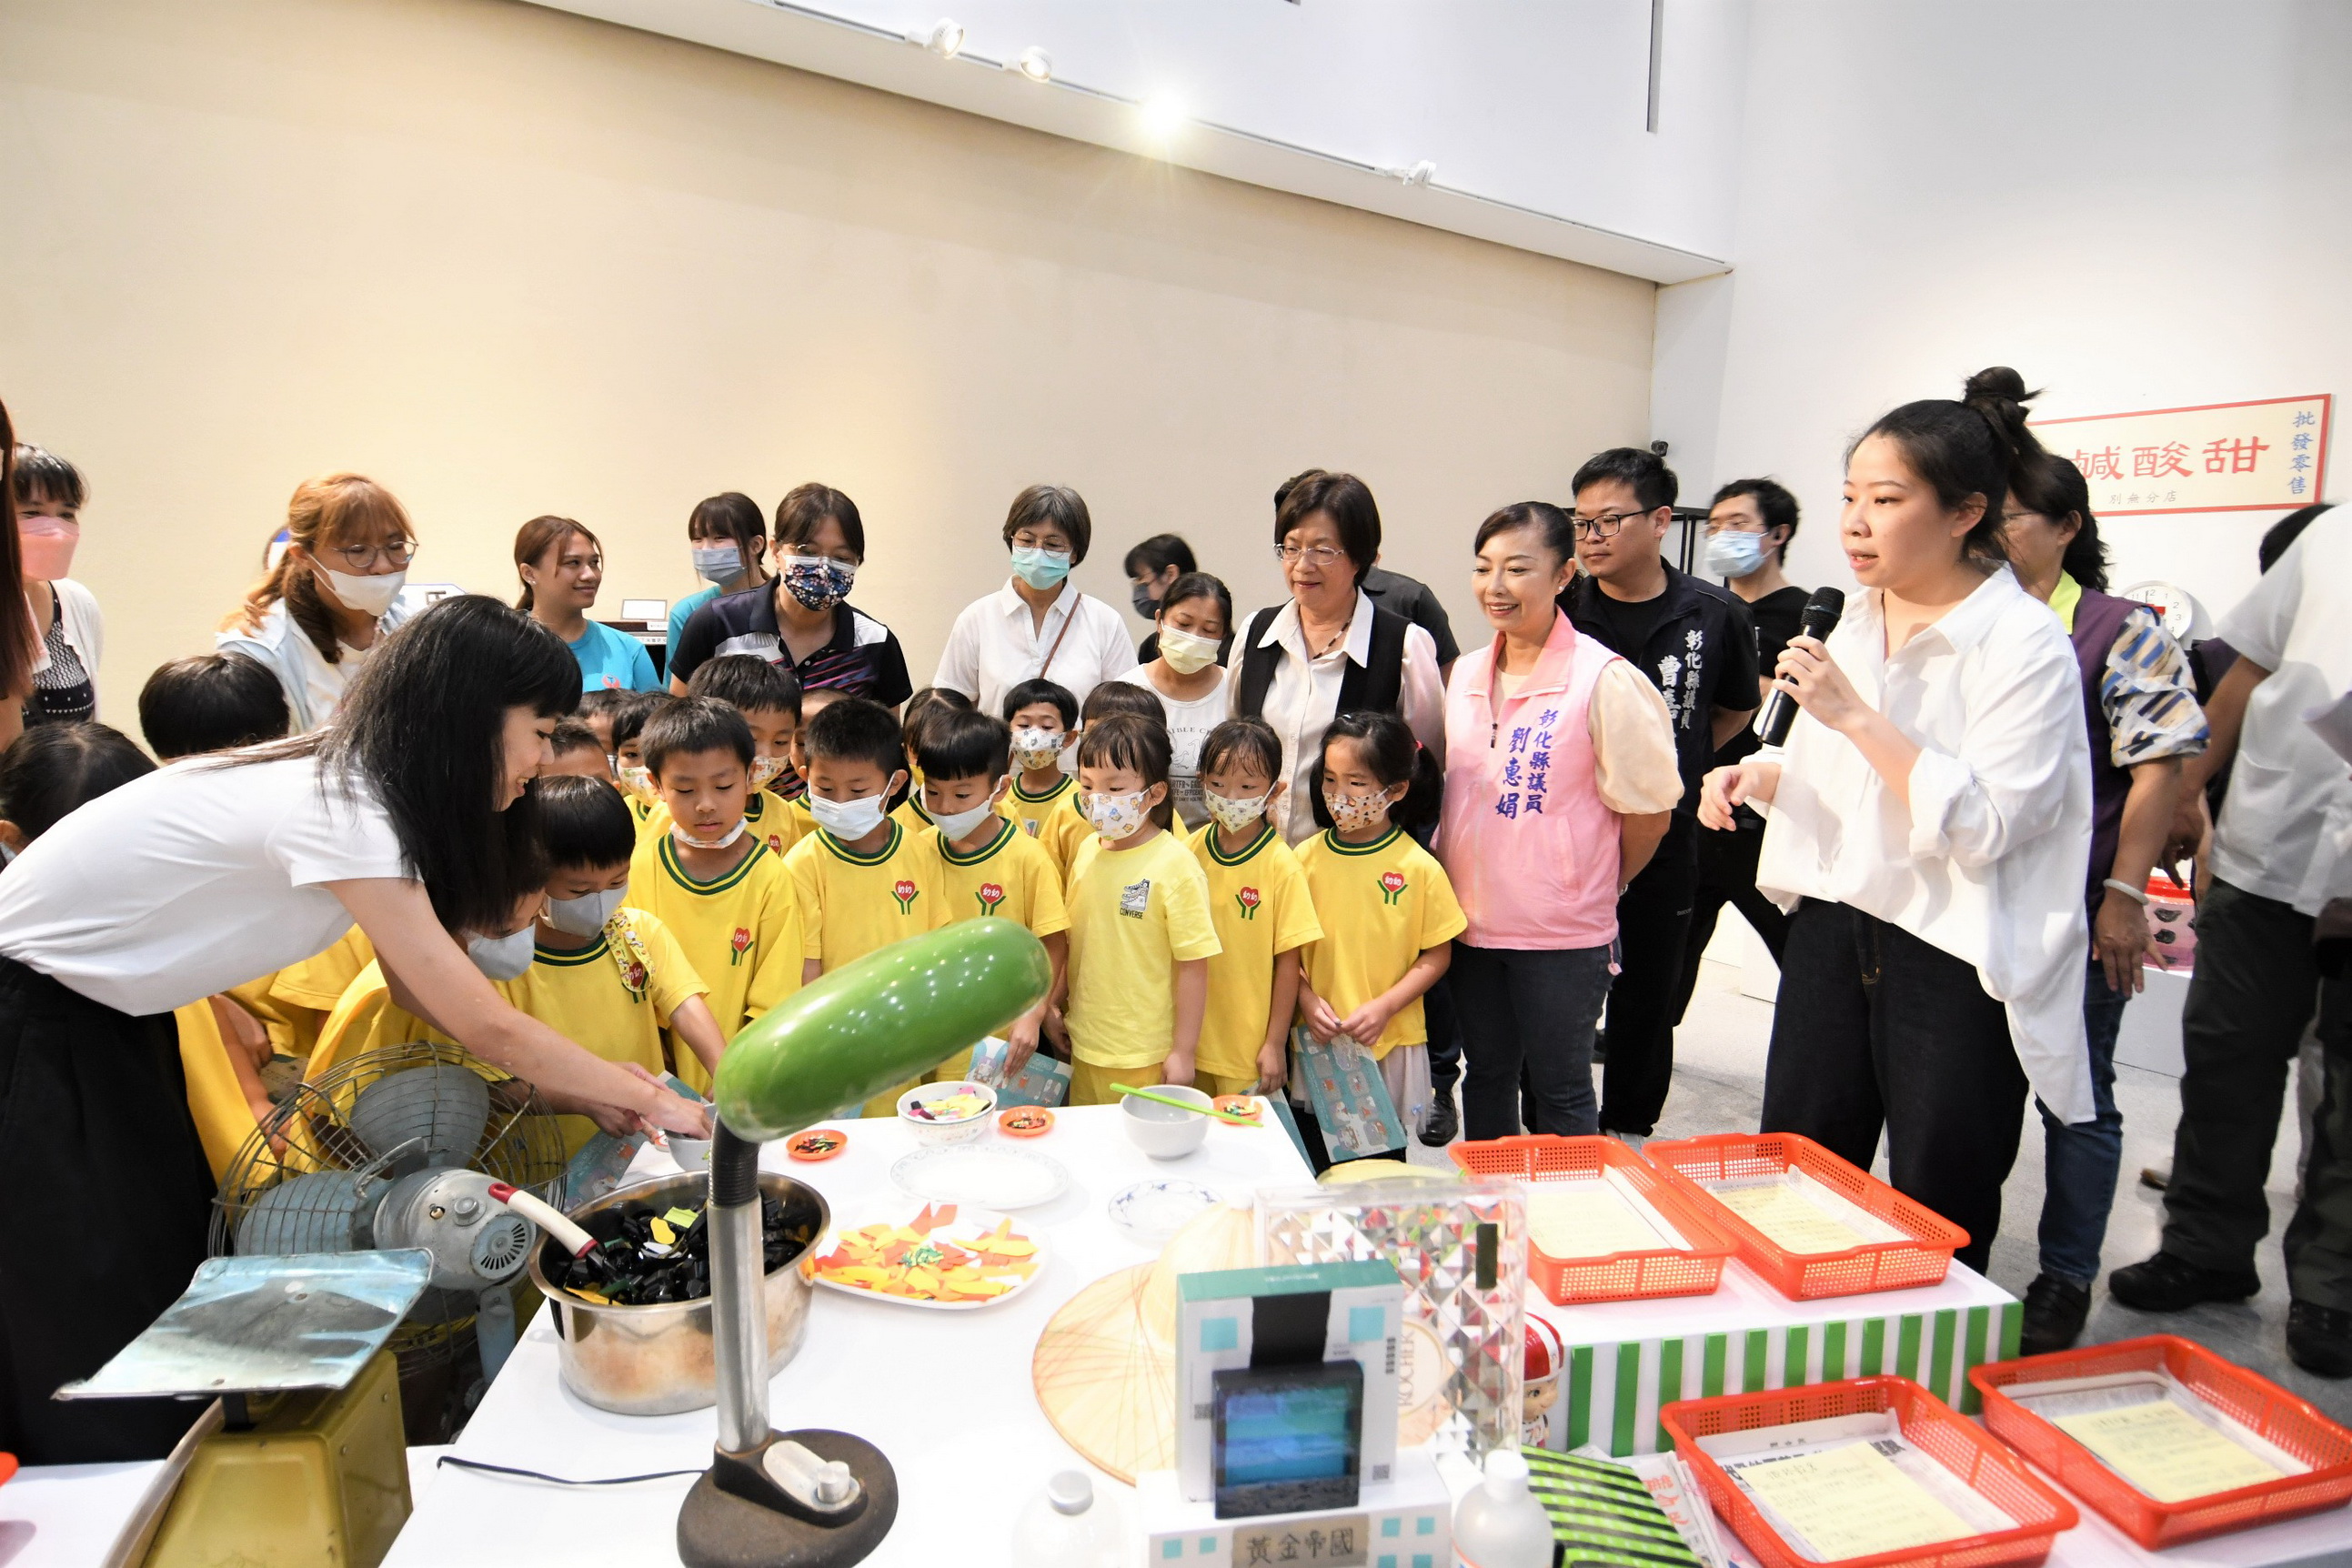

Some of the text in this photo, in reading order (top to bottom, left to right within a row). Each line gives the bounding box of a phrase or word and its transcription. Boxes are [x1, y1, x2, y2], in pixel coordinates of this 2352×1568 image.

[2069, 436, 2271, 480] 鹹酸甜
[2287, 411, 2316, 495] 批發零售
[2109, 490, 2176, 505] 別無分店
[2173, 601, 2180, 609] 2
[1680, 629, 1704, 729] 彰化縣議員
[1523, 709, 1558, 814] 彰化縣議員
[1495, 727, 1532, 819] 劉惠娟
[897, 884, 912, 894] 幼幼
[982, 886, 1000, 898] 幼幼
[1242, 890, 1258, 901] 幼幼
[1120, 907, 1143, 920] CONVERSE
